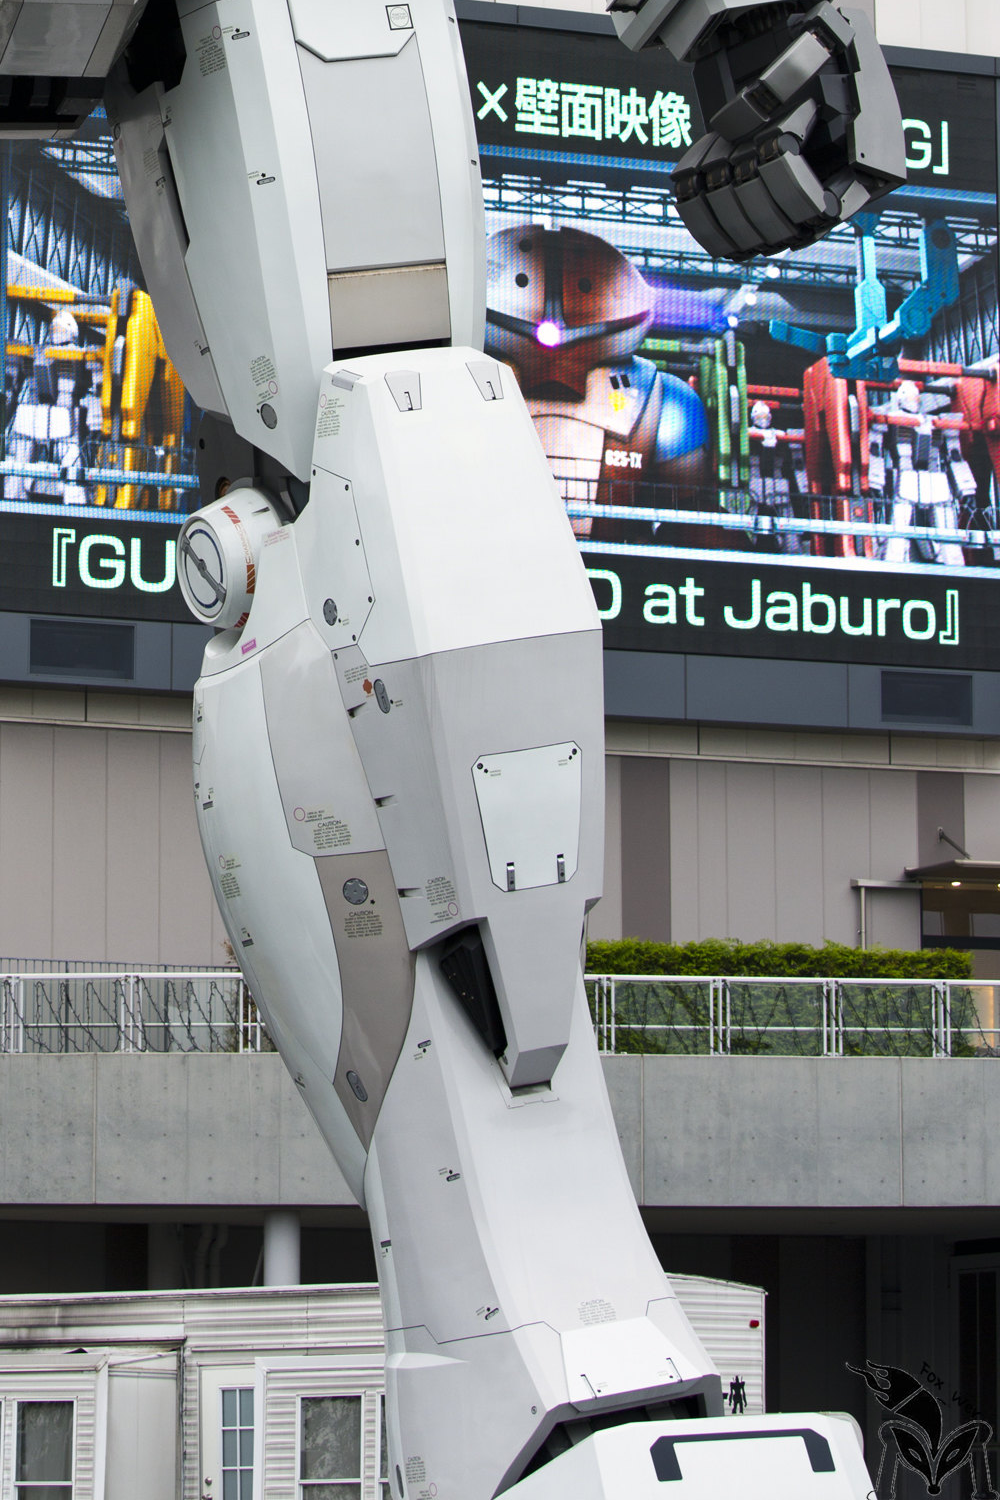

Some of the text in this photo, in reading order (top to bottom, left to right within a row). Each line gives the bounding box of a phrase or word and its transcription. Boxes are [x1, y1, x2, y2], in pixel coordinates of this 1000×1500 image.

[643, 577, 705, 626] at
[317, 819, 342, 828] CAUTION
[348, 909, 374, 918] CAUTION
